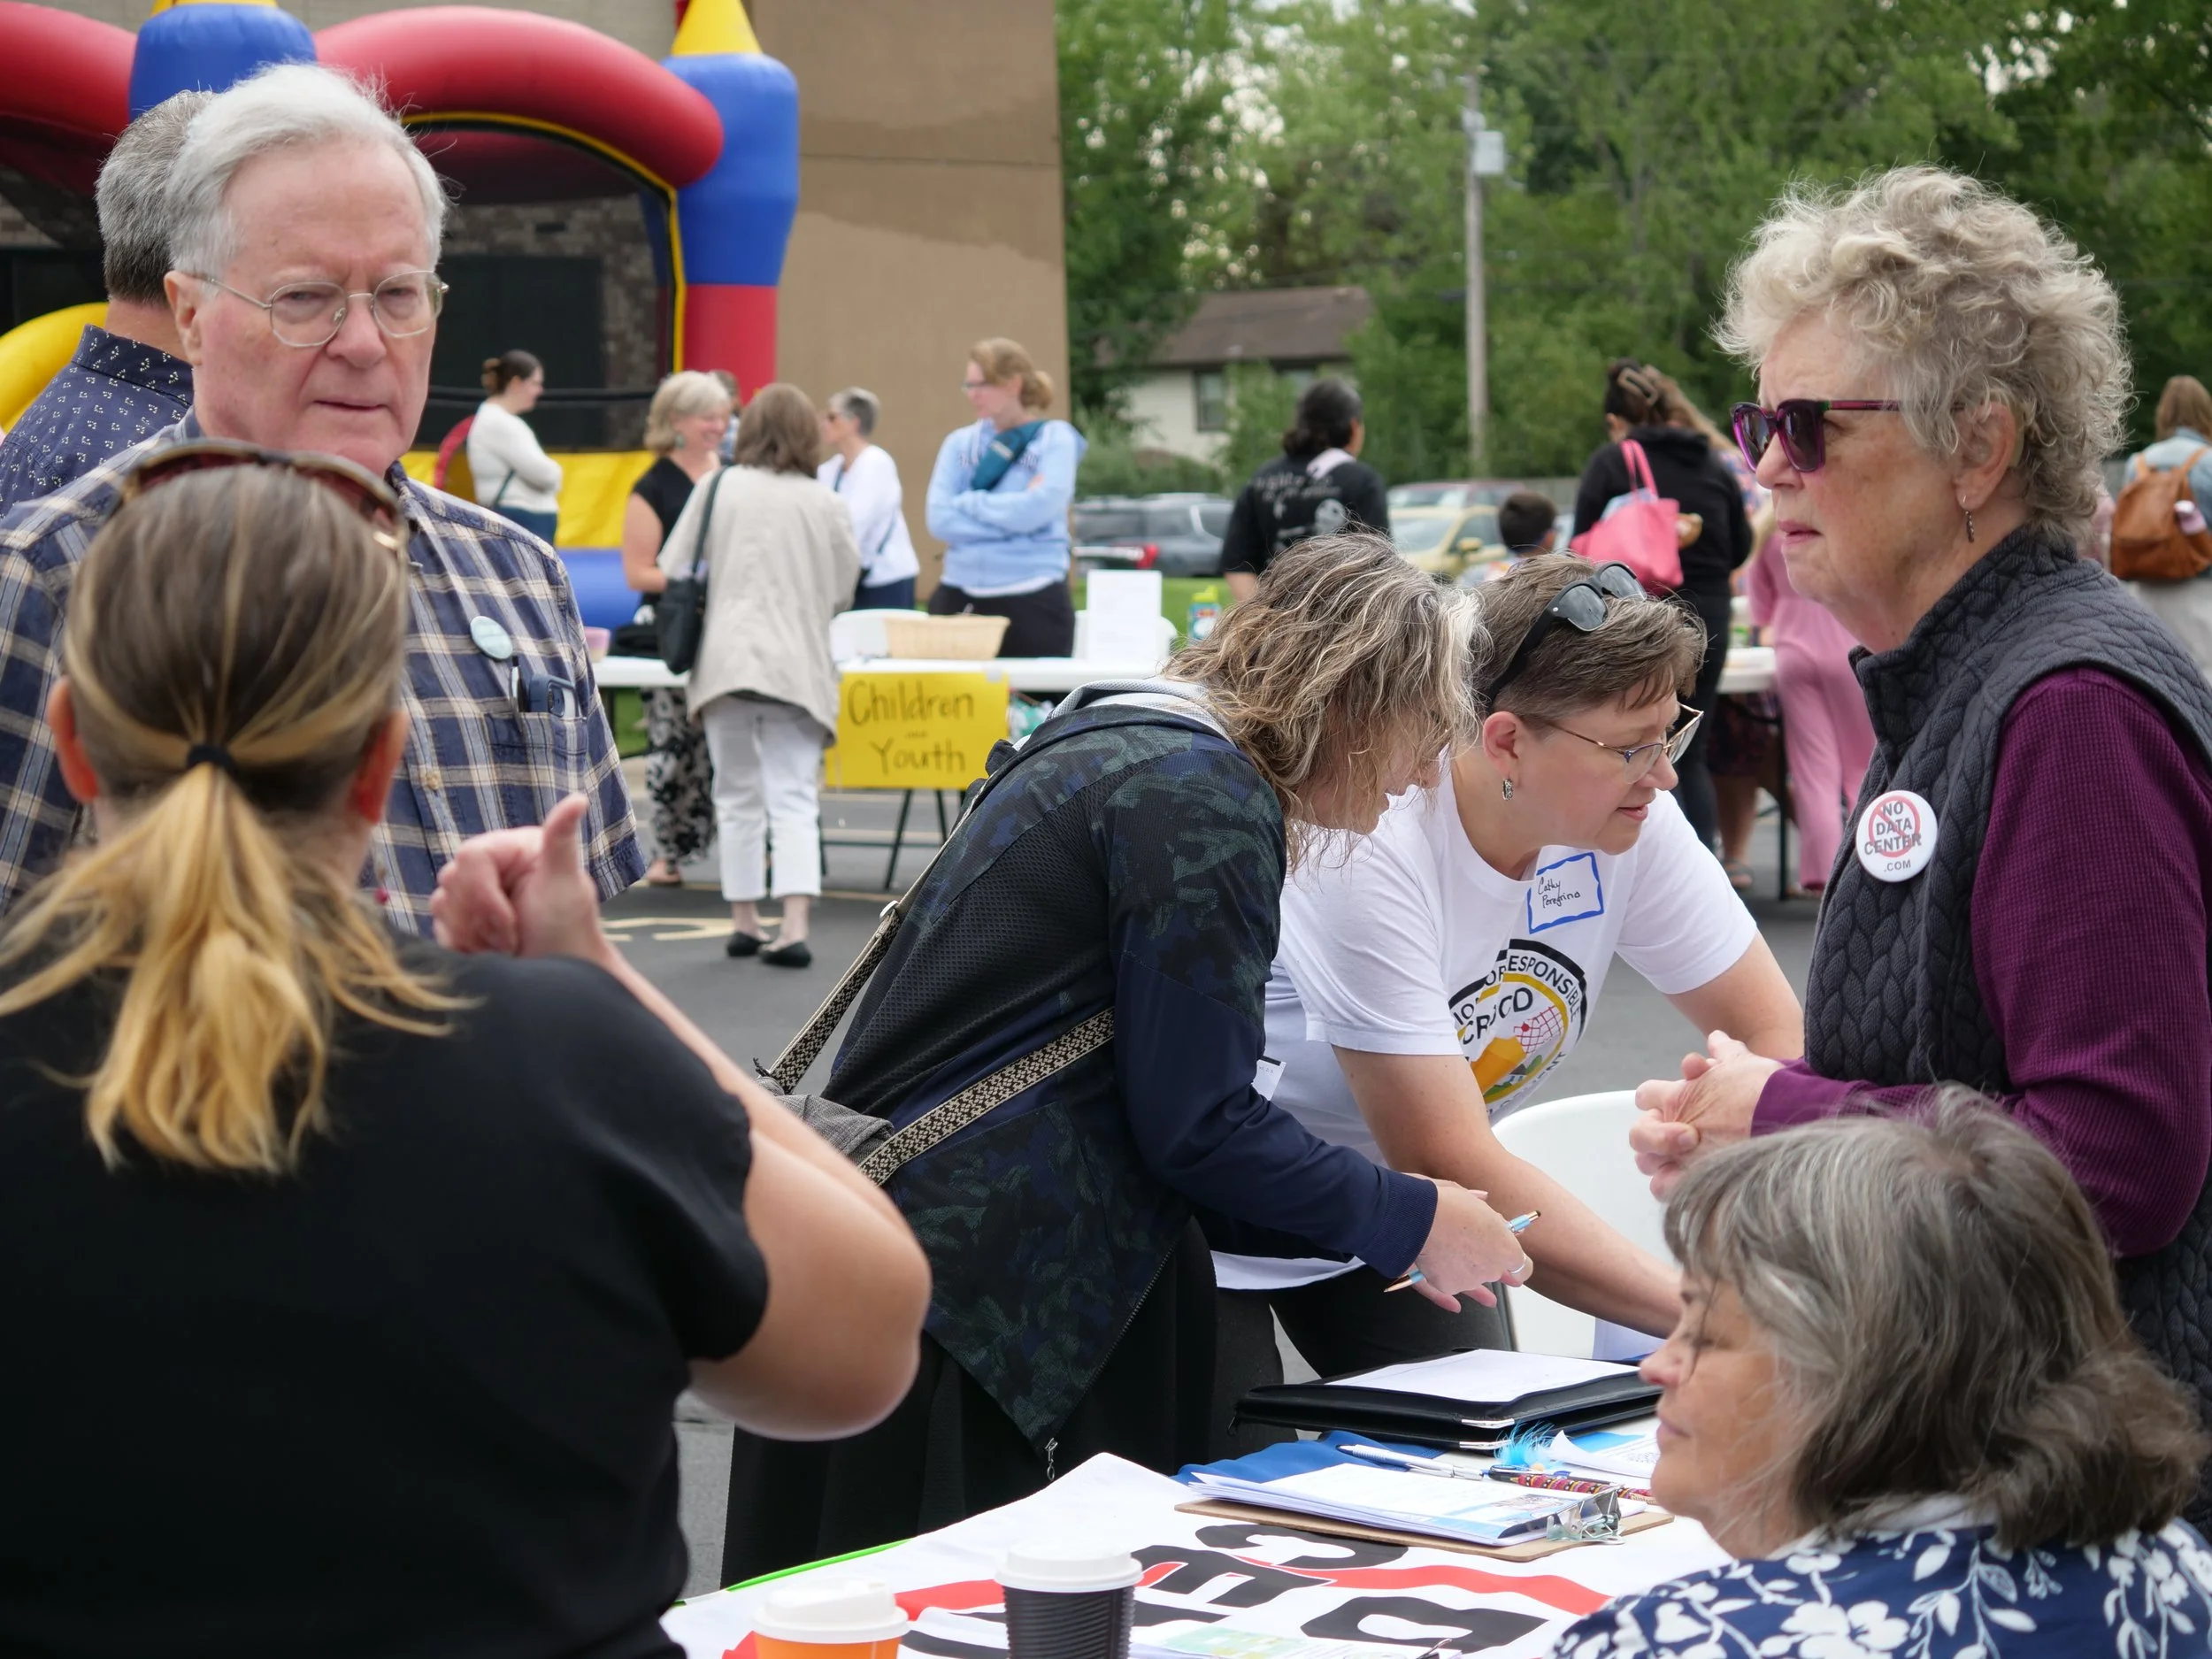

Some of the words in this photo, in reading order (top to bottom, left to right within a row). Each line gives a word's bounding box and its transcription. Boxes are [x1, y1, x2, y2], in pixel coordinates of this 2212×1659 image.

[847, 680, 973, 726] Children
[869, 737, 966, 775] Youth
[1883, 801, 1904, 816] NO
[1876, 818, 1913, 835] DATA
[1864, 833, 1922, 855] CENTER
[1884, 859, 1911, 872] .COM
